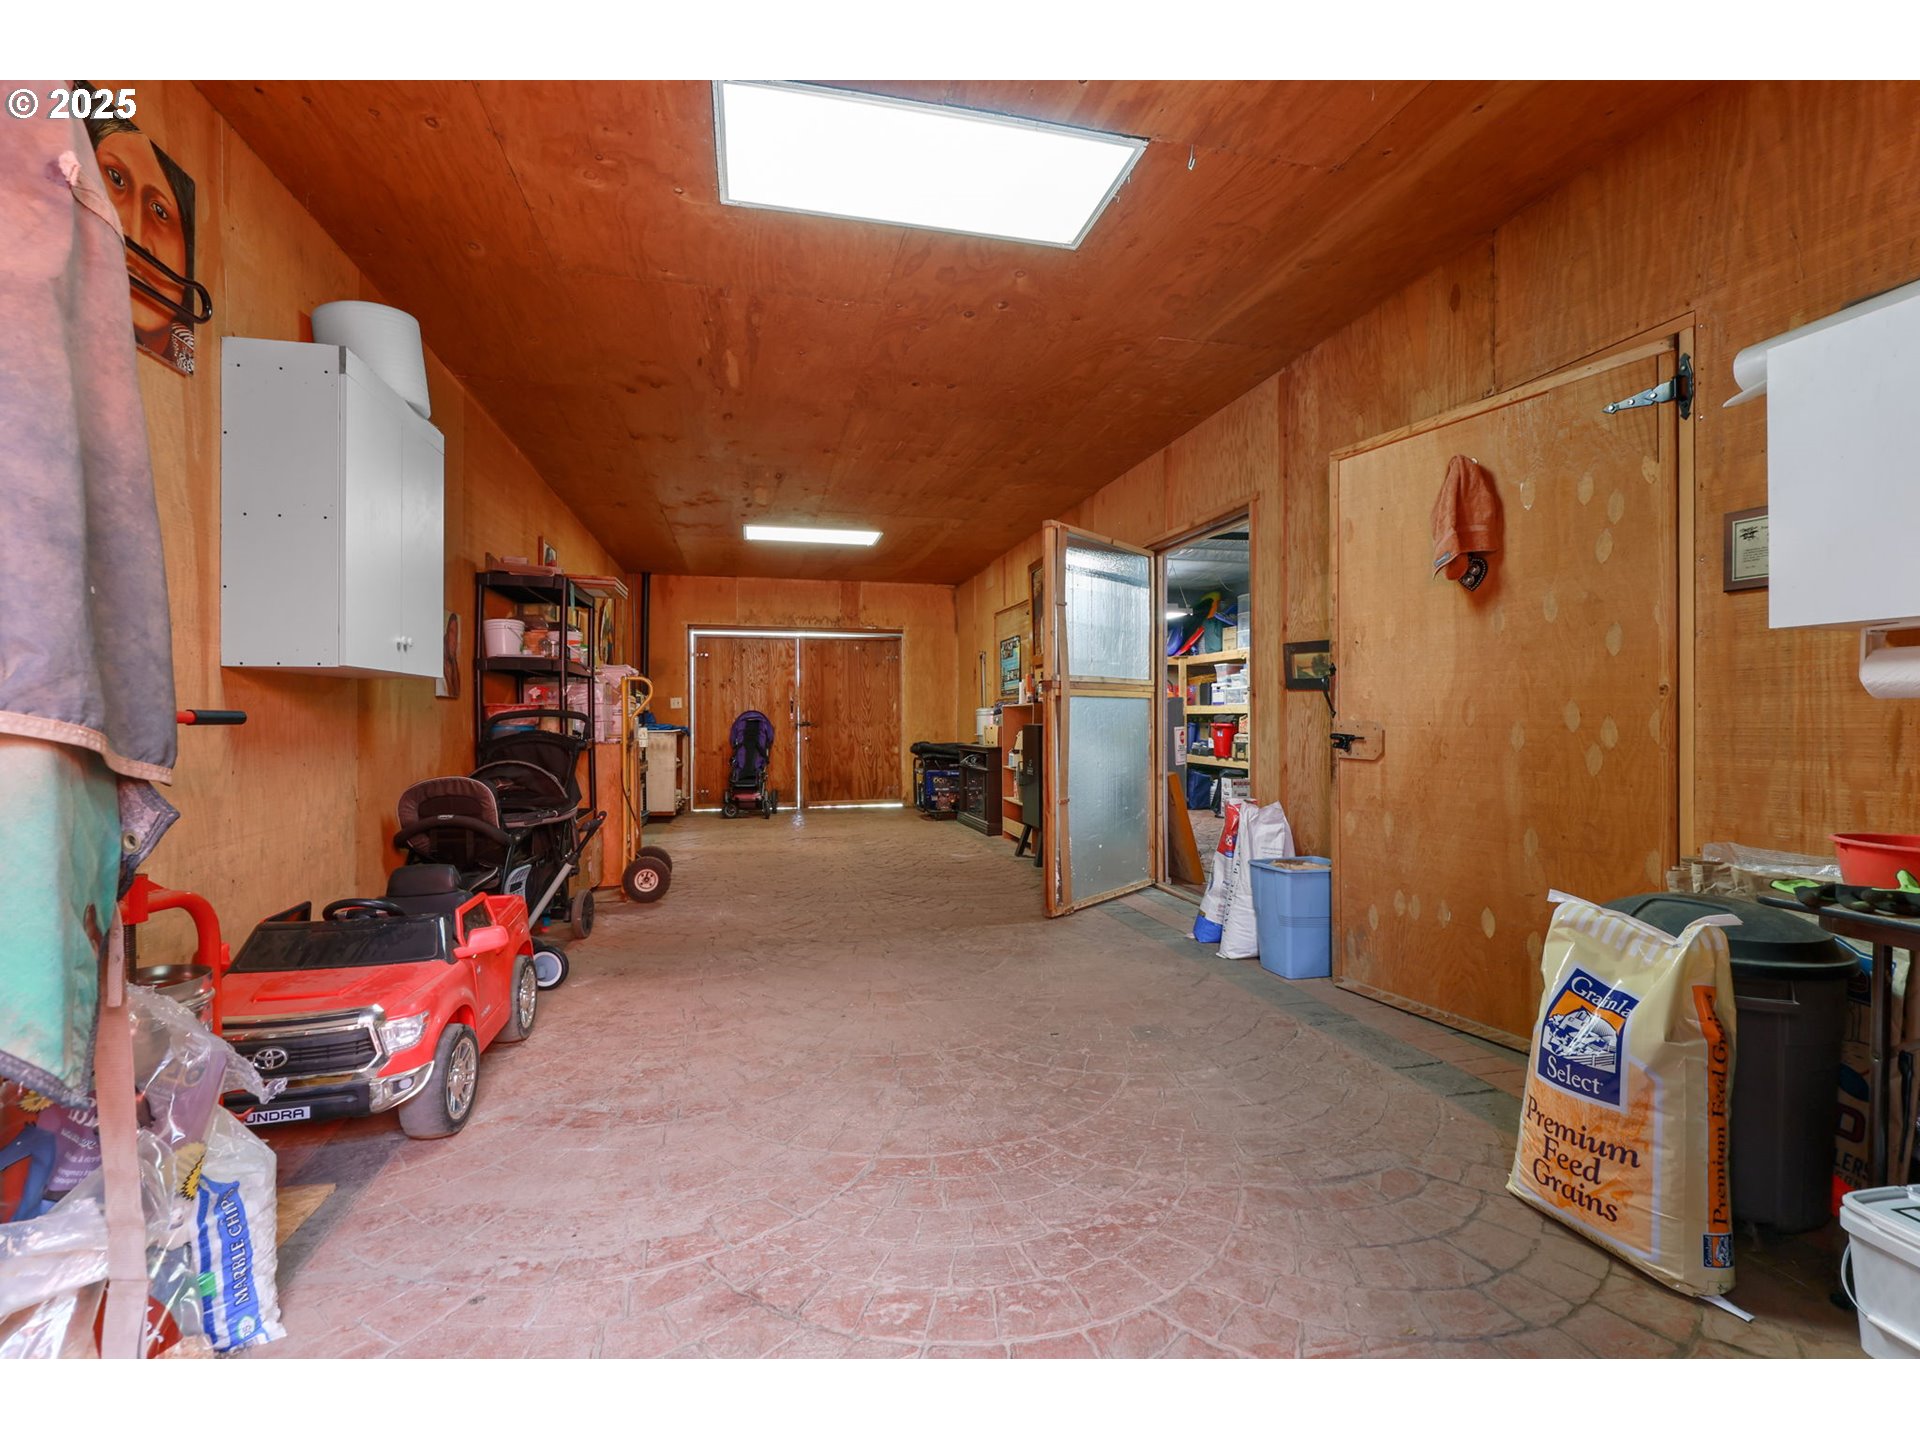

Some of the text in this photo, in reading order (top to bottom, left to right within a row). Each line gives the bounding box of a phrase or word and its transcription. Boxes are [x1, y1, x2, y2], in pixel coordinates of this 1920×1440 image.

[1571, 976, 1633, 1018] Grainla
[1546, 1055, 1600, 1094] Select
[1712, 1070, 1726, 1117] Feed
[245, 1109, 305, 1123] UNDRA
[1526, 1095, 1641, 1168] Premium
[1543, 1134, 1601, 1185] Feed
[1712, 1126, 1728, 1225] Premium
[221, 1188, 243, 1238] CHIPS
[1533, 1158, 1618, 1222] Grains
[231, 1239, 250, 1305] MARBLE
